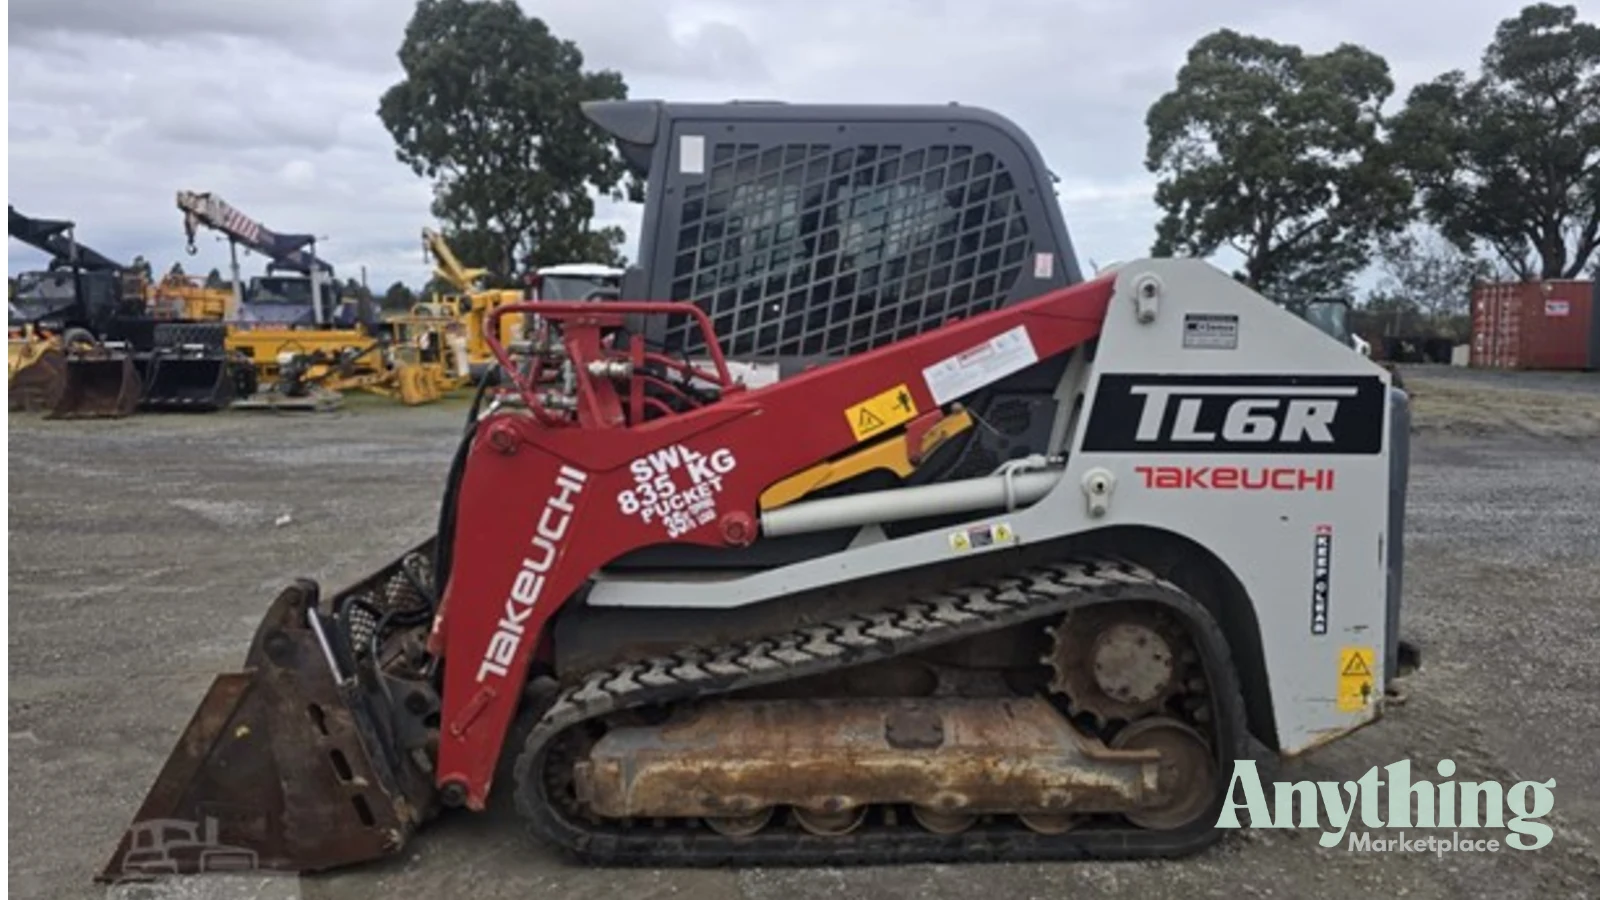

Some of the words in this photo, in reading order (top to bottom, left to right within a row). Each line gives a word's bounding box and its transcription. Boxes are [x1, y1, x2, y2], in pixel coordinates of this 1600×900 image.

[1130, 385, 1358, 442] TL6R
[617, 473, 676, 515] 835
[686, 448, 736, 483] KG
[630, 444, 701, 482] SWL
[1134, 466, 1335, 491] TAKEUCHI
[476, 465, 588, 683] TAKEUCHI
